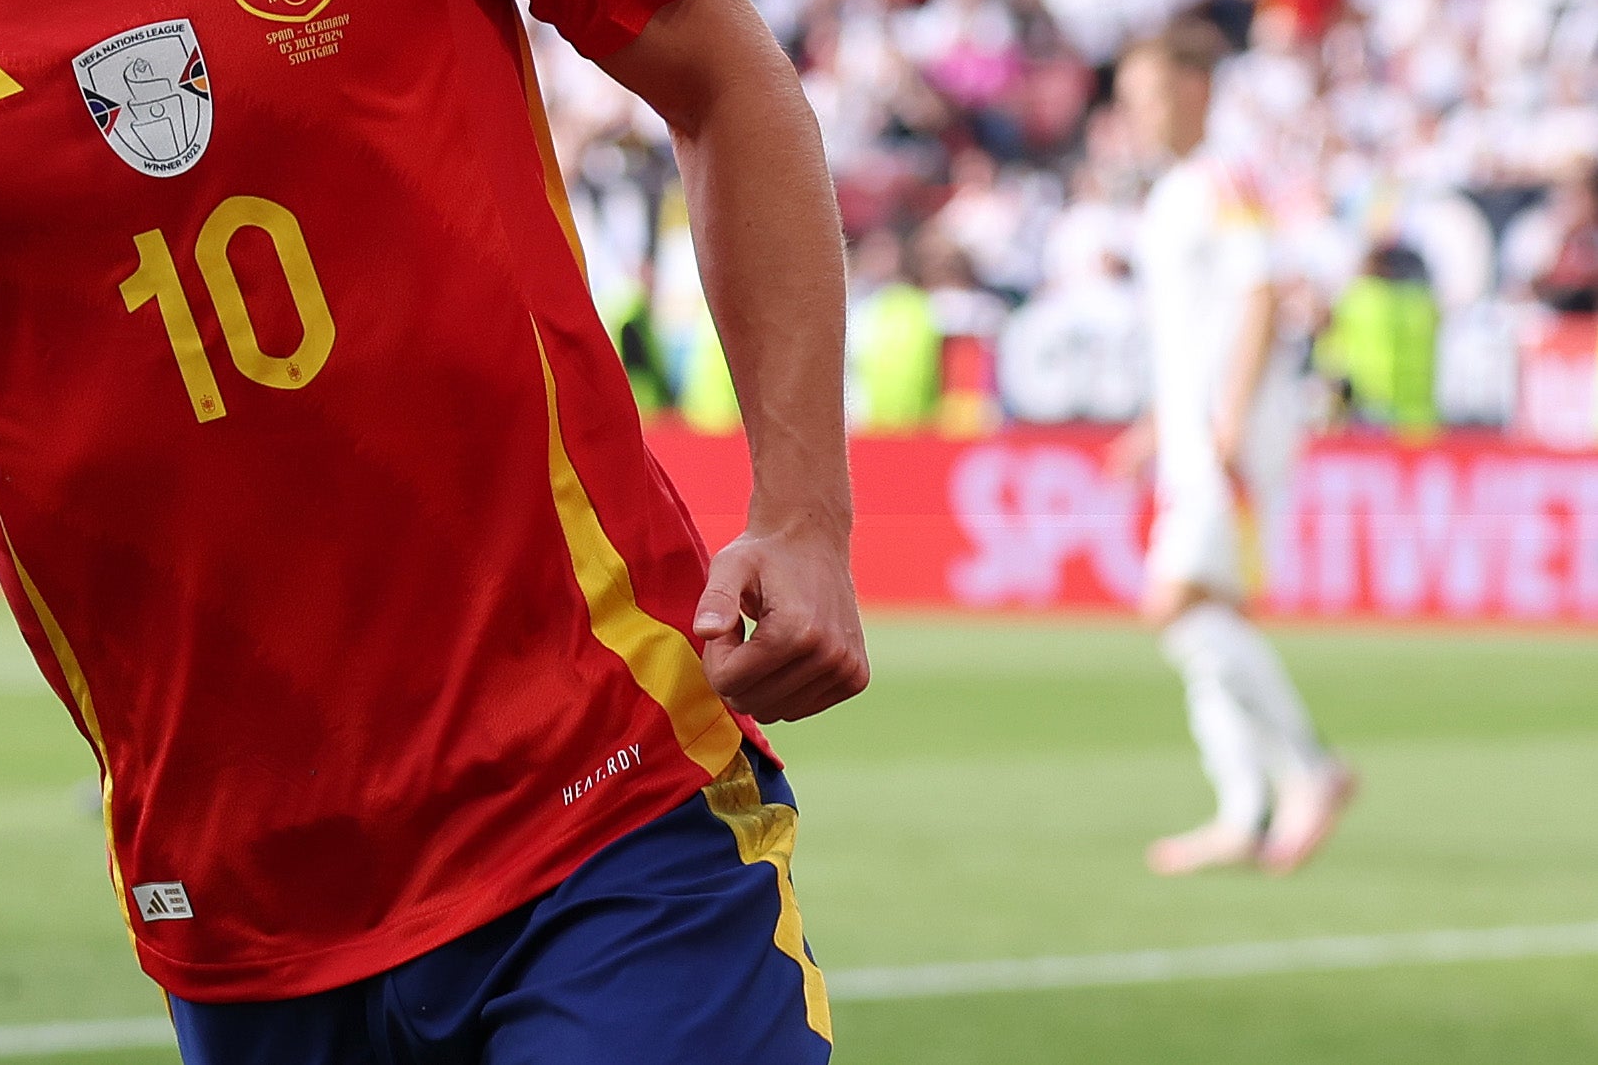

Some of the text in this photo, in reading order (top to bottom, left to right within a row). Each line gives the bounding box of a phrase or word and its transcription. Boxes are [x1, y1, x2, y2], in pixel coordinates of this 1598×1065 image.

[265, 28, 295, 45] SPAIN
[304, 13, 350, 34] GERMANY
[279, 29, 344, 55] 05 JULY 2024
[78, 23, 185, 69] UEFA NATIONS LEAGUE
[288, 42, 339, 66] STUTTGART
[143, 142, 201, 171] WINNER 2023
[118, 195, 336, 423] 10
[562, 743, 641, 806] HEAT.RDY
